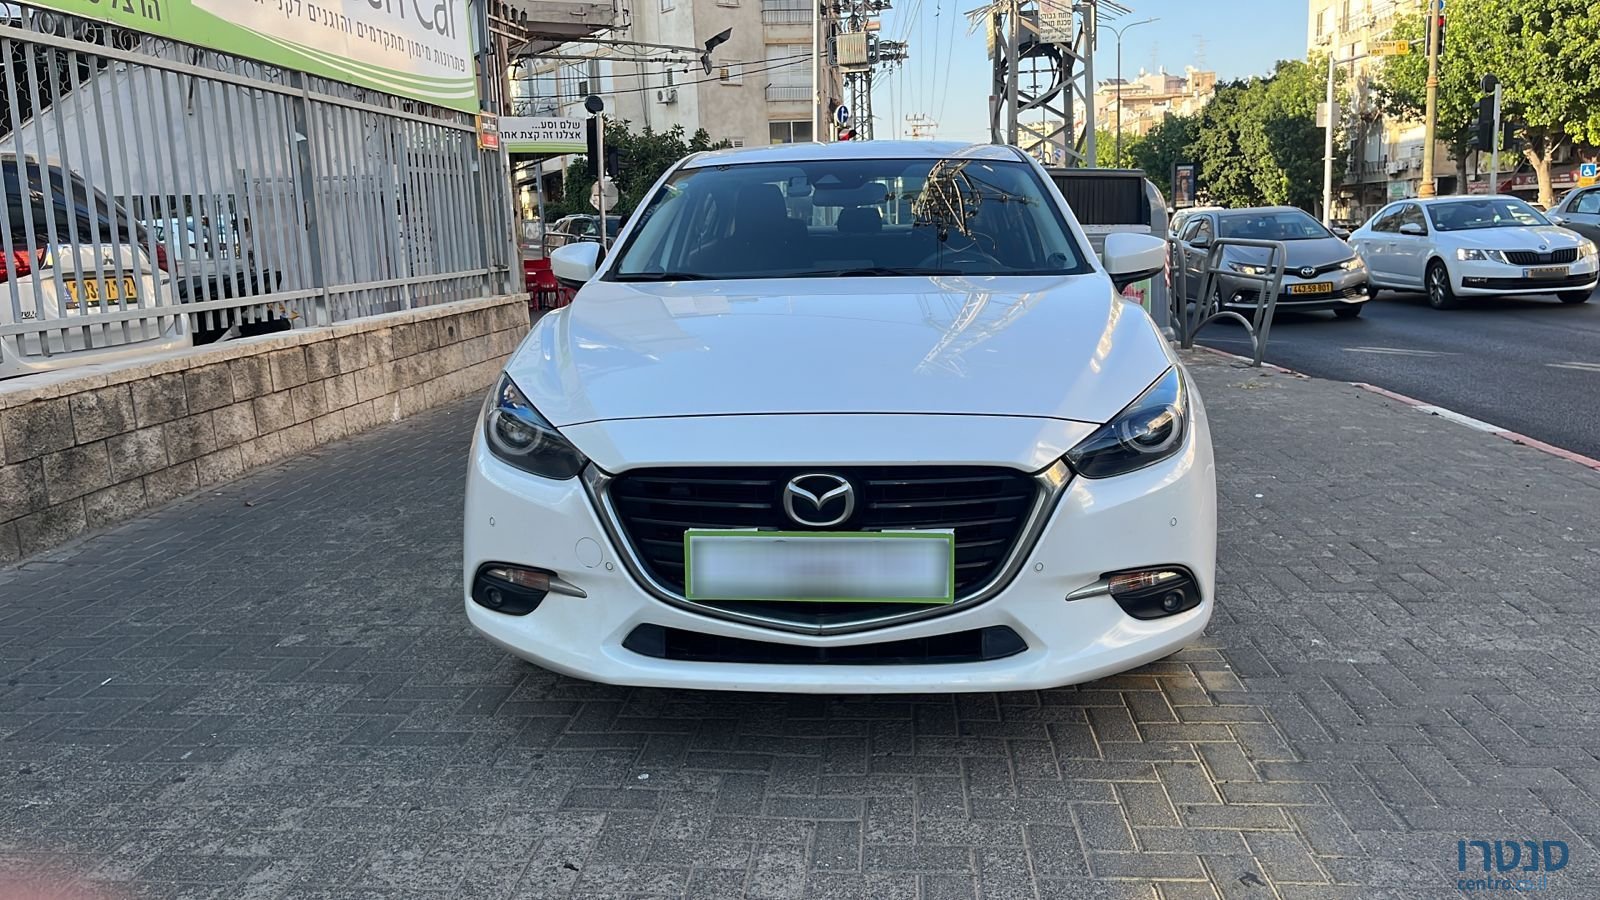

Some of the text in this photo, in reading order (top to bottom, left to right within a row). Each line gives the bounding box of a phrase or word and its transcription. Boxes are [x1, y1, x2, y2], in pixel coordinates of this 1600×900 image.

[308, 4, 352, 34] והוגנים
[357, 21, 404, 52] מתקדמים
[407, 40, 431, 61] מימון
[434, 49, 465, 72] פתרונות
[560, 120, 580, 129] שלם
[520, 131, 540, 141] קצת
[543, 131, 553, 139] זה
[556, 130, 581, 139] אצלנו
